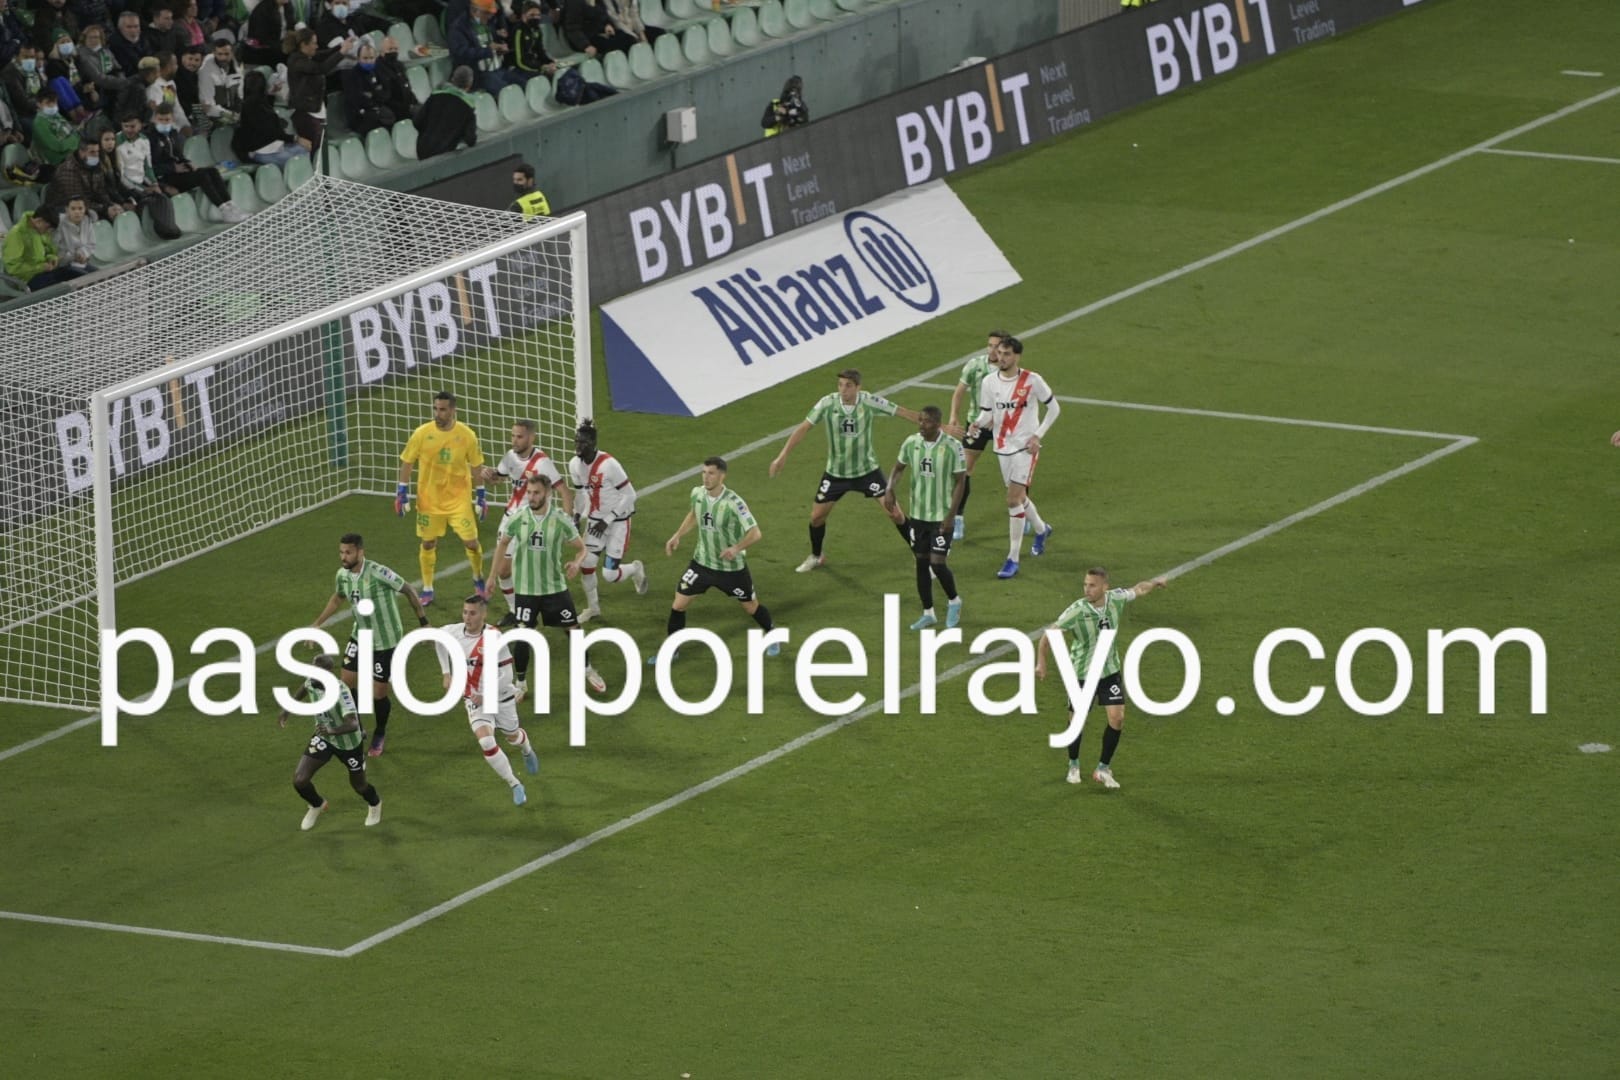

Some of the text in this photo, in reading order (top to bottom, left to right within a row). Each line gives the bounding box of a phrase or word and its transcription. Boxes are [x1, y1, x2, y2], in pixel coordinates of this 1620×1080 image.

[1293, 19, 1336, 44] Trading
[1146, 0, 1276, 95] BYBIT
[1040, 61, 1068, 84] Next
[1044, 85, 1075, 109] Level
[896, 63, 1030, 185] BYBIT
[1048, 108, 1091, 135] Trading
[782, 152, 811, 175] Next
[787, 175, 820, 201] Level
[629, 153, 774, 283] BYBIT
[791, 201, 836, 226] Trading
[350, 253, 500, 384] BYBIT
[691, 254, 886, 366] Allianz
[820, 479, 831, 493] 3
[681, 568, 699, 585] 21
[516, 606, 531, 622] 16
